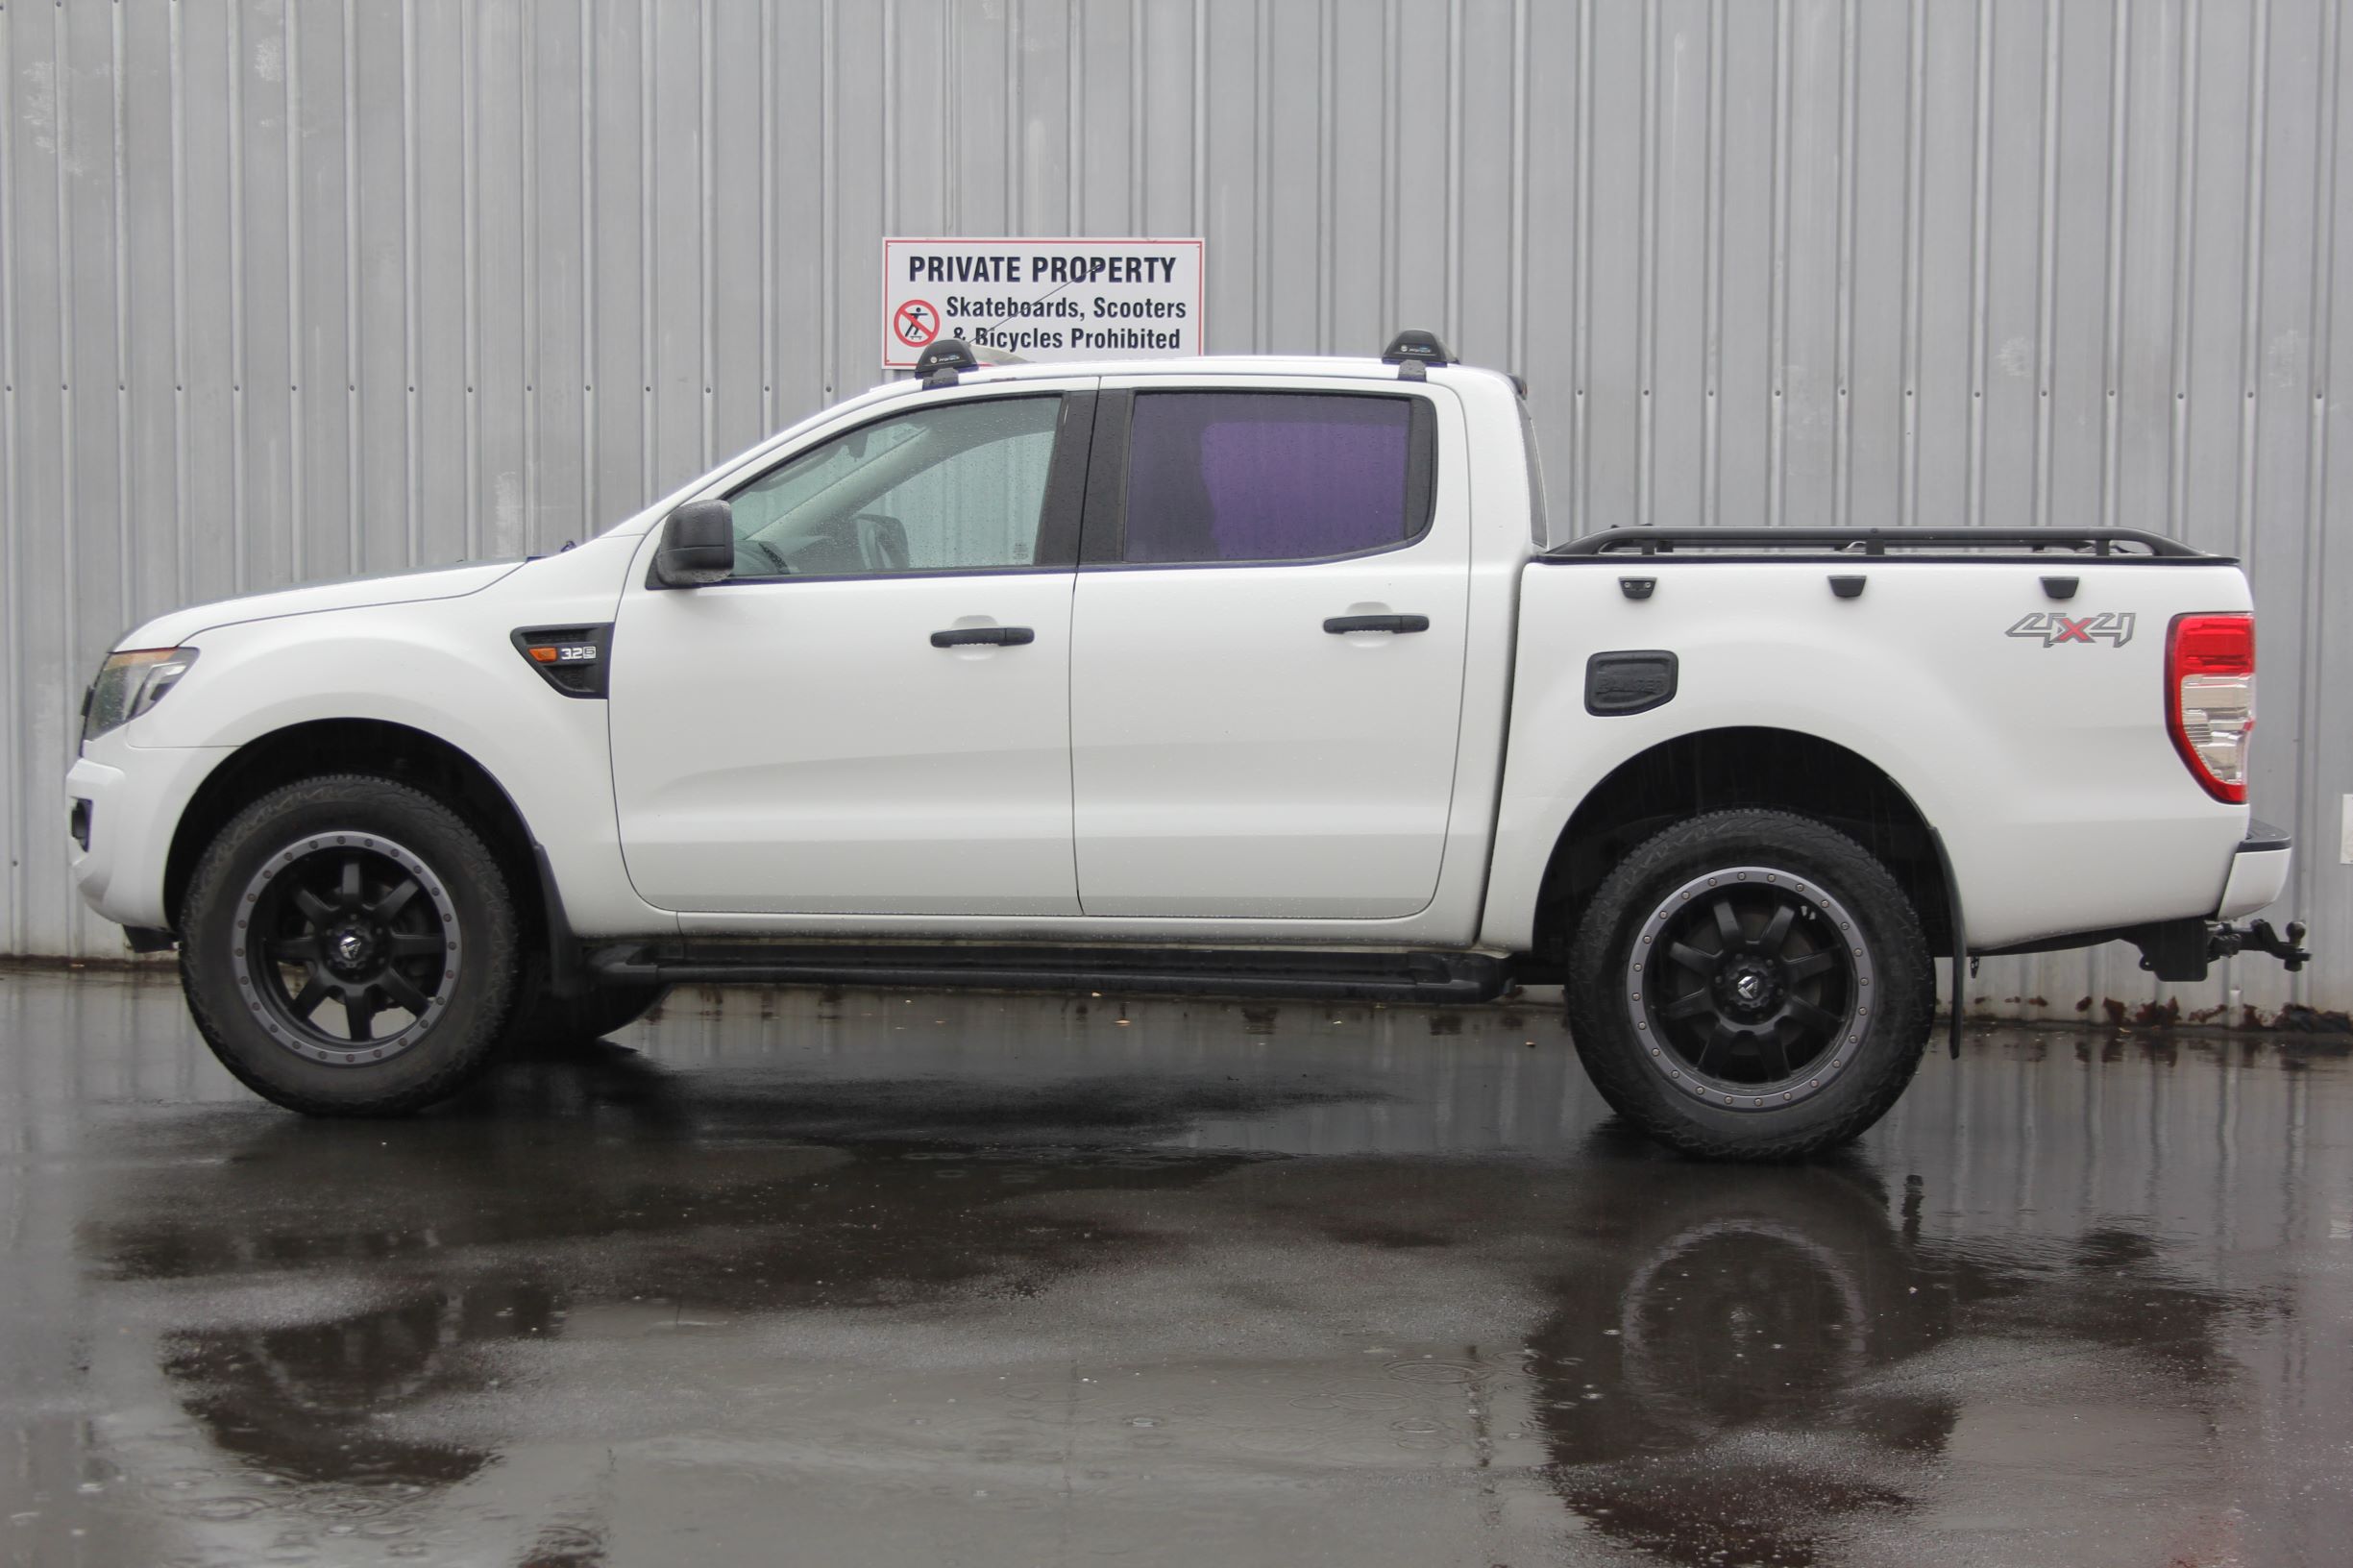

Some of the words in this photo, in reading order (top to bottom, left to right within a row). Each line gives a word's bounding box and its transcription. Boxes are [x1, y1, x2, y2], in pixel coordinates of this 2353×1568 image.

[909, 256, 1021, 282] PRIVATE
[1032, 256, 1176, 283] PROPERTY
[946, 296, 1085, 321] Skateboards,
[1093, 296, 1187, 318] Scooters
[975, 327, 1063, 353] Bicycles
[1071, 328, 1180, 349] Prohibited
